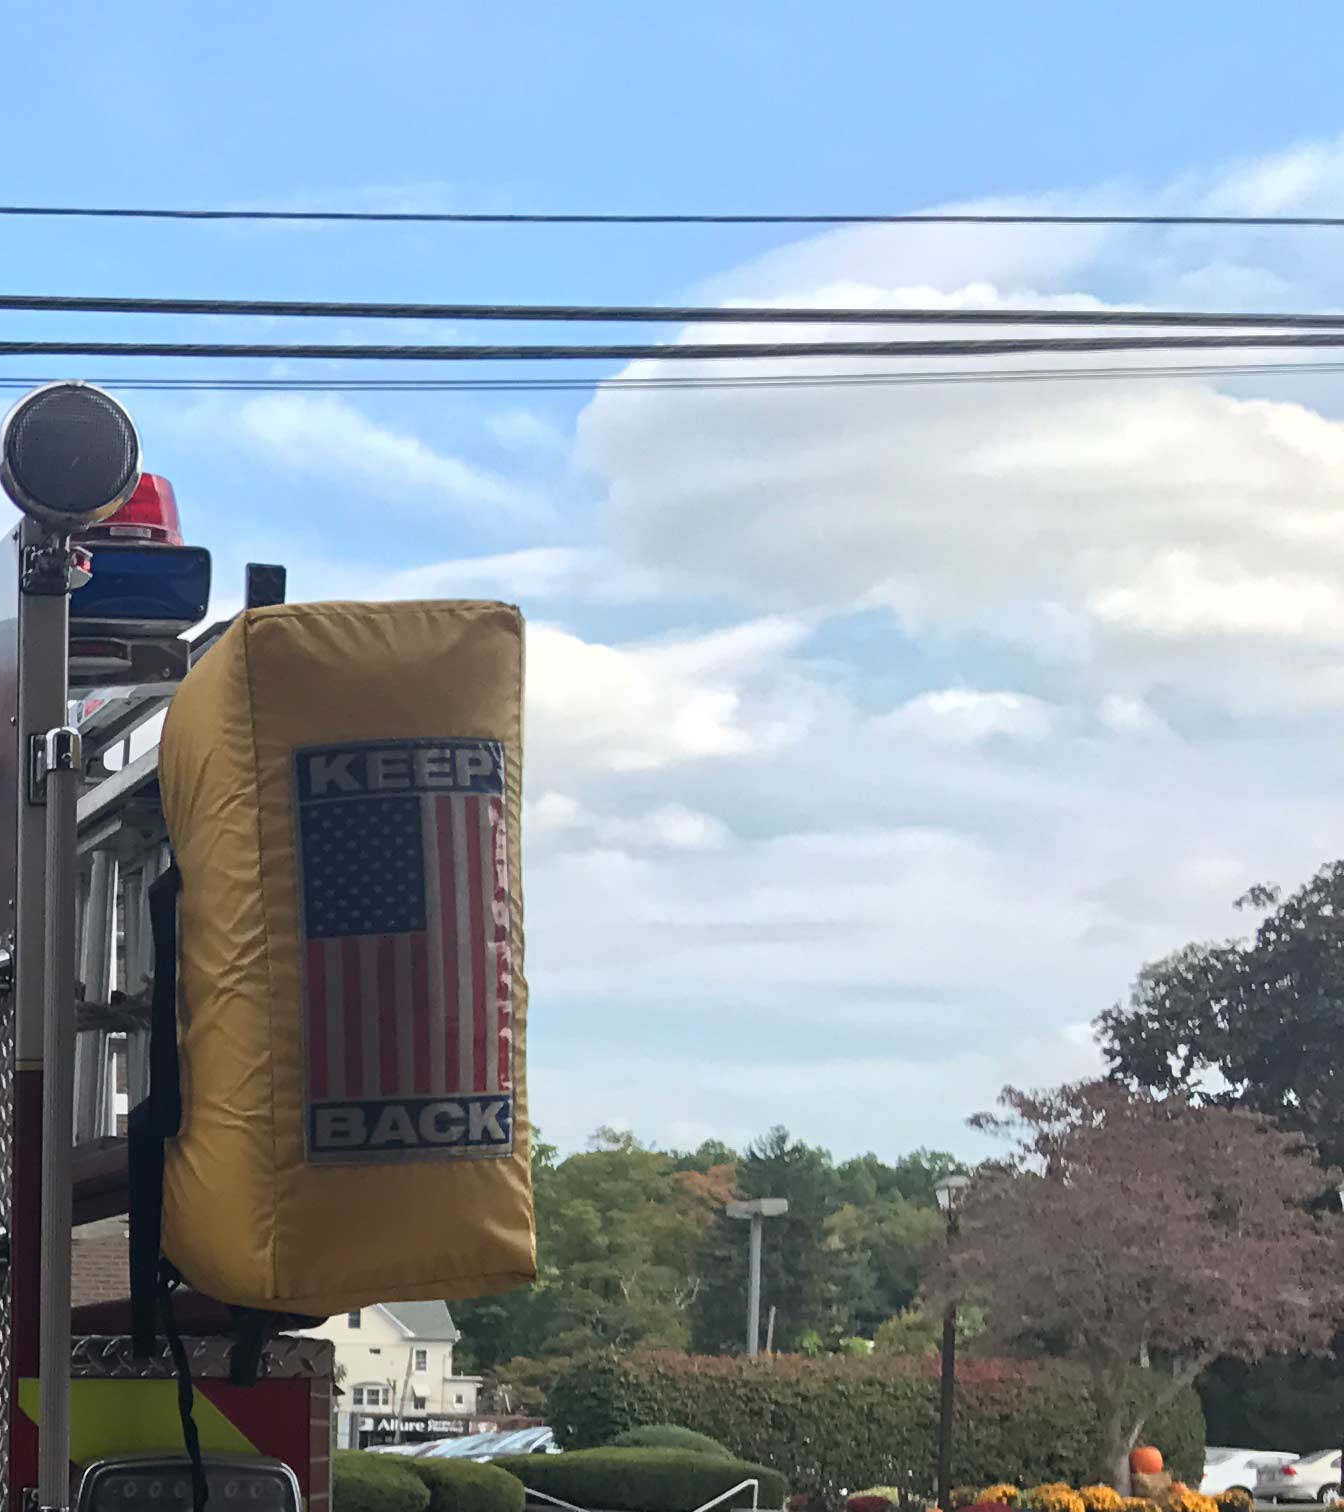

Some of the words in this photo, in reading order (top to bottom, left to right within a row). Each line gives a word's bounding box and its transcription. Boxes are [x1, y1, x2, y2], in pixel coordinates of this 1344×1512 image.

[310, 748, 494, 794] KEEP
[315, 1102, 506, 1147] BACK
[378, 1418, 425, 1433] Allure
